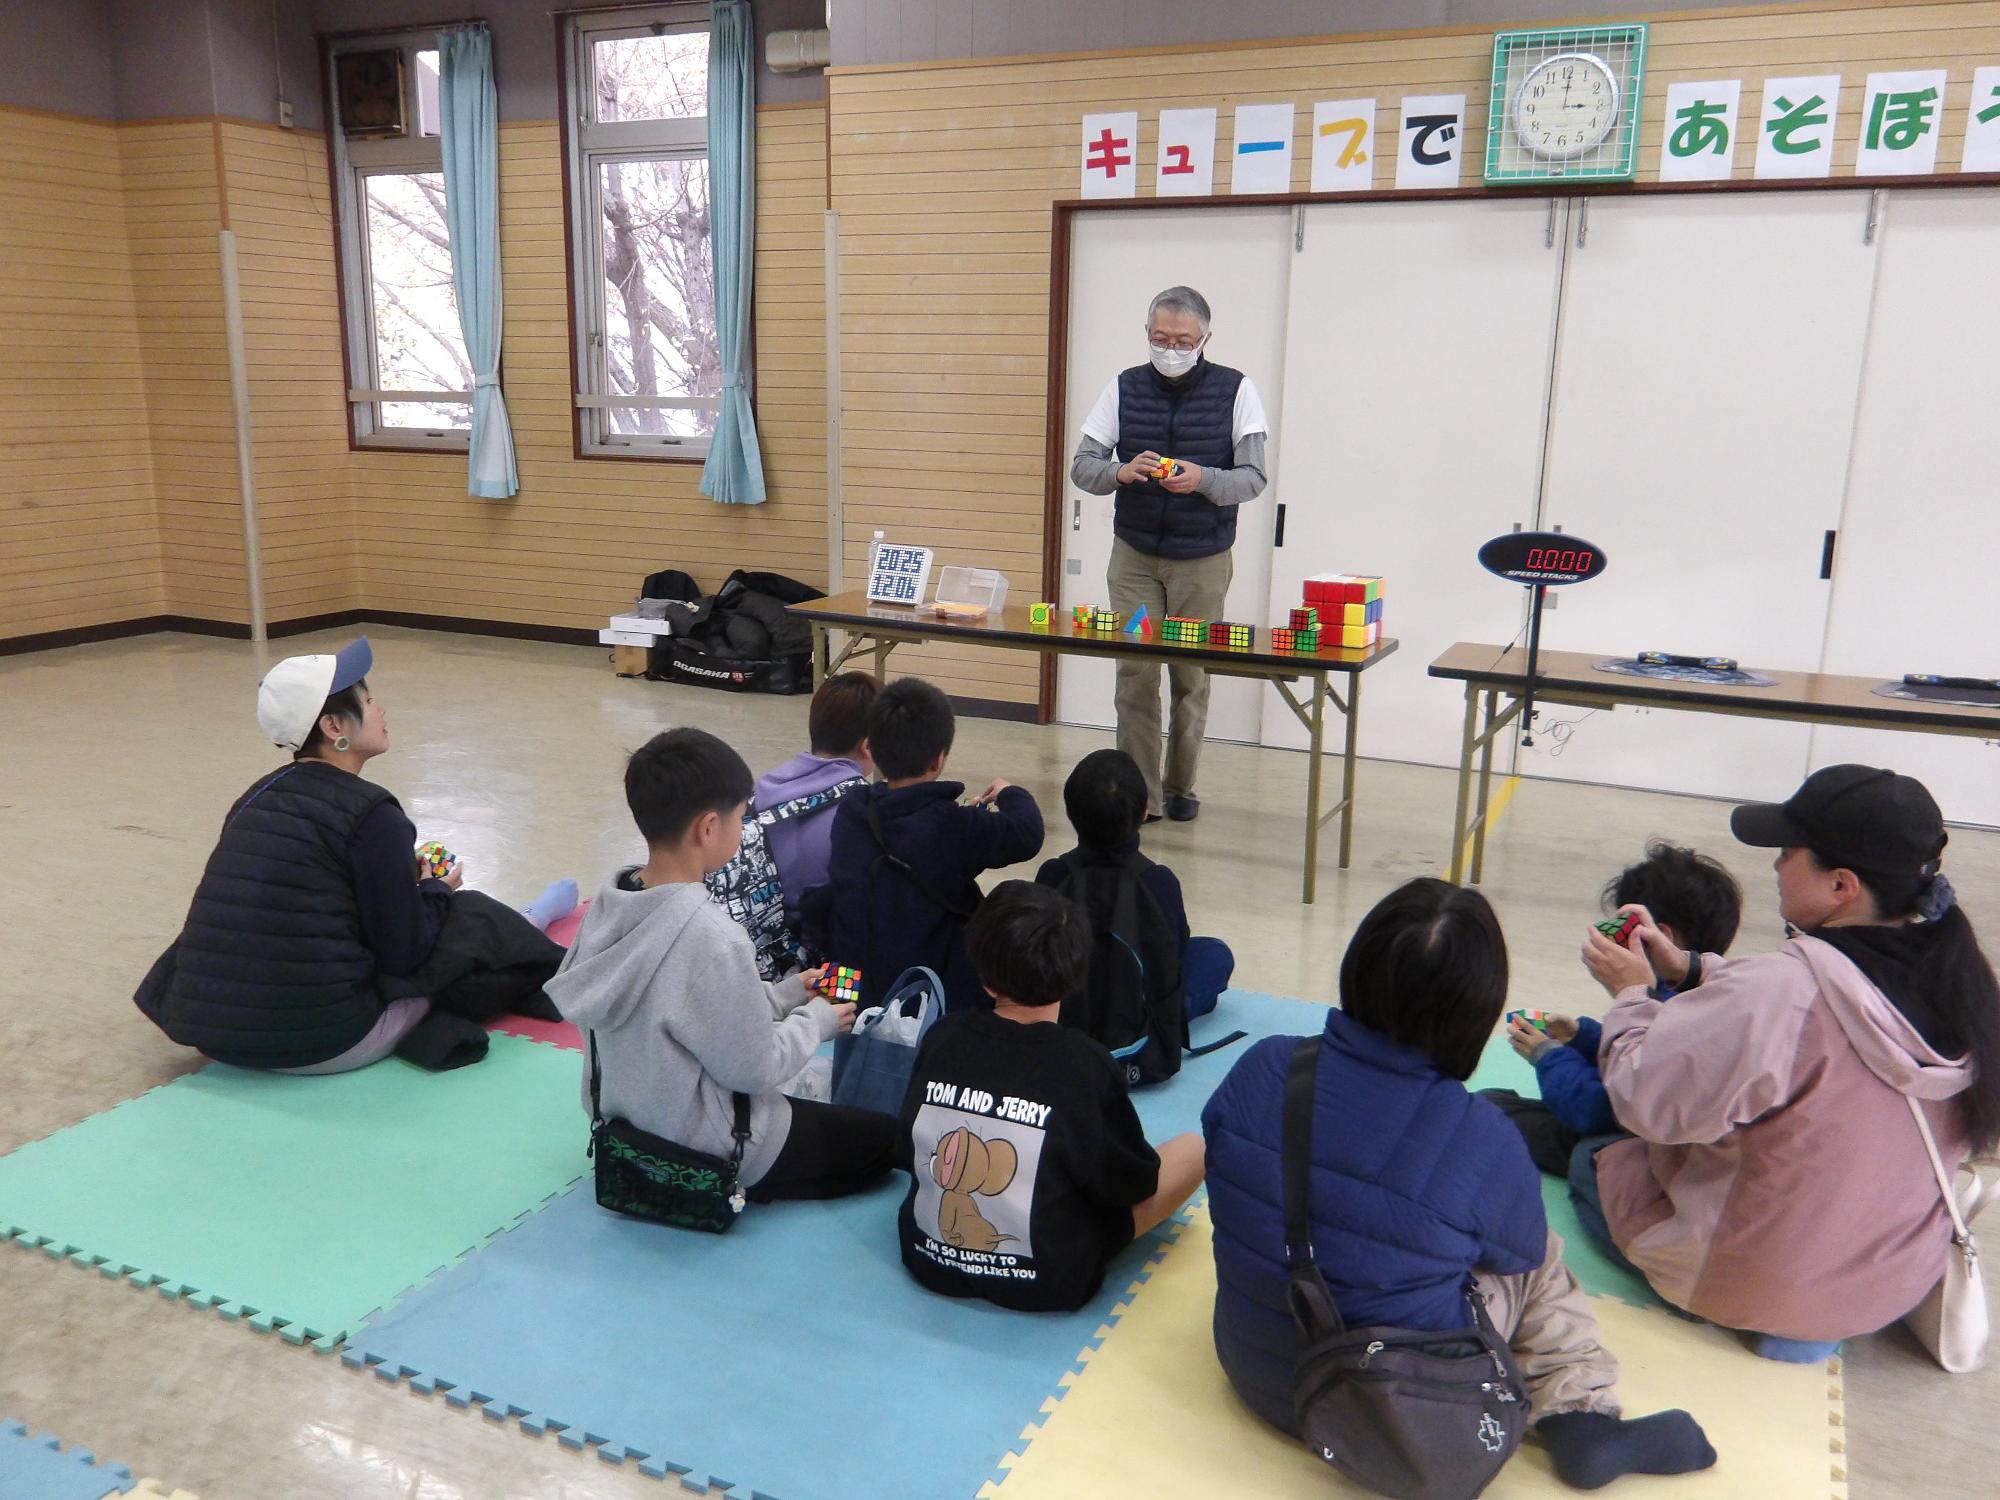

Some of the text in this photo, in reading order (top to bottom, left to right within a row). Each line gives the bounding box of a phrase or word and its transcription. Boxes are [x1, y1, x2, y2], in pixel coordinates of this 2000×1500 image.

[1545, 71, 1556, 85] 11
[1561, 65, 1574, 80] 12
[1533, 85, 1545, 99] 10
[1592, 81, 1601, 95] 2
[1526, 103, 1536, 115] 9
[1542, 132, 1551, 145] 7
[1557, 134, 1567, 147] 6
[1575, 131, 1584, 143] 5
[1086, 114, 1458, 179] キューブで
[878, 548, 925, 574] 2025
[1526, 549, 1593, 572] 0.000
[673, 660, 731, 679] OGASAKA
[925, 1080, 1052, 1127] TOM AND JERRY
[941, 1245, 957, 1258] SO
[960, 1250, 997, 1264] LUCKY
[1000, 1256, 1017, 1266] TO
[983, 1265, 1010, 1277] LIKE
[1011, 1268, 1036, 1280] YOU
